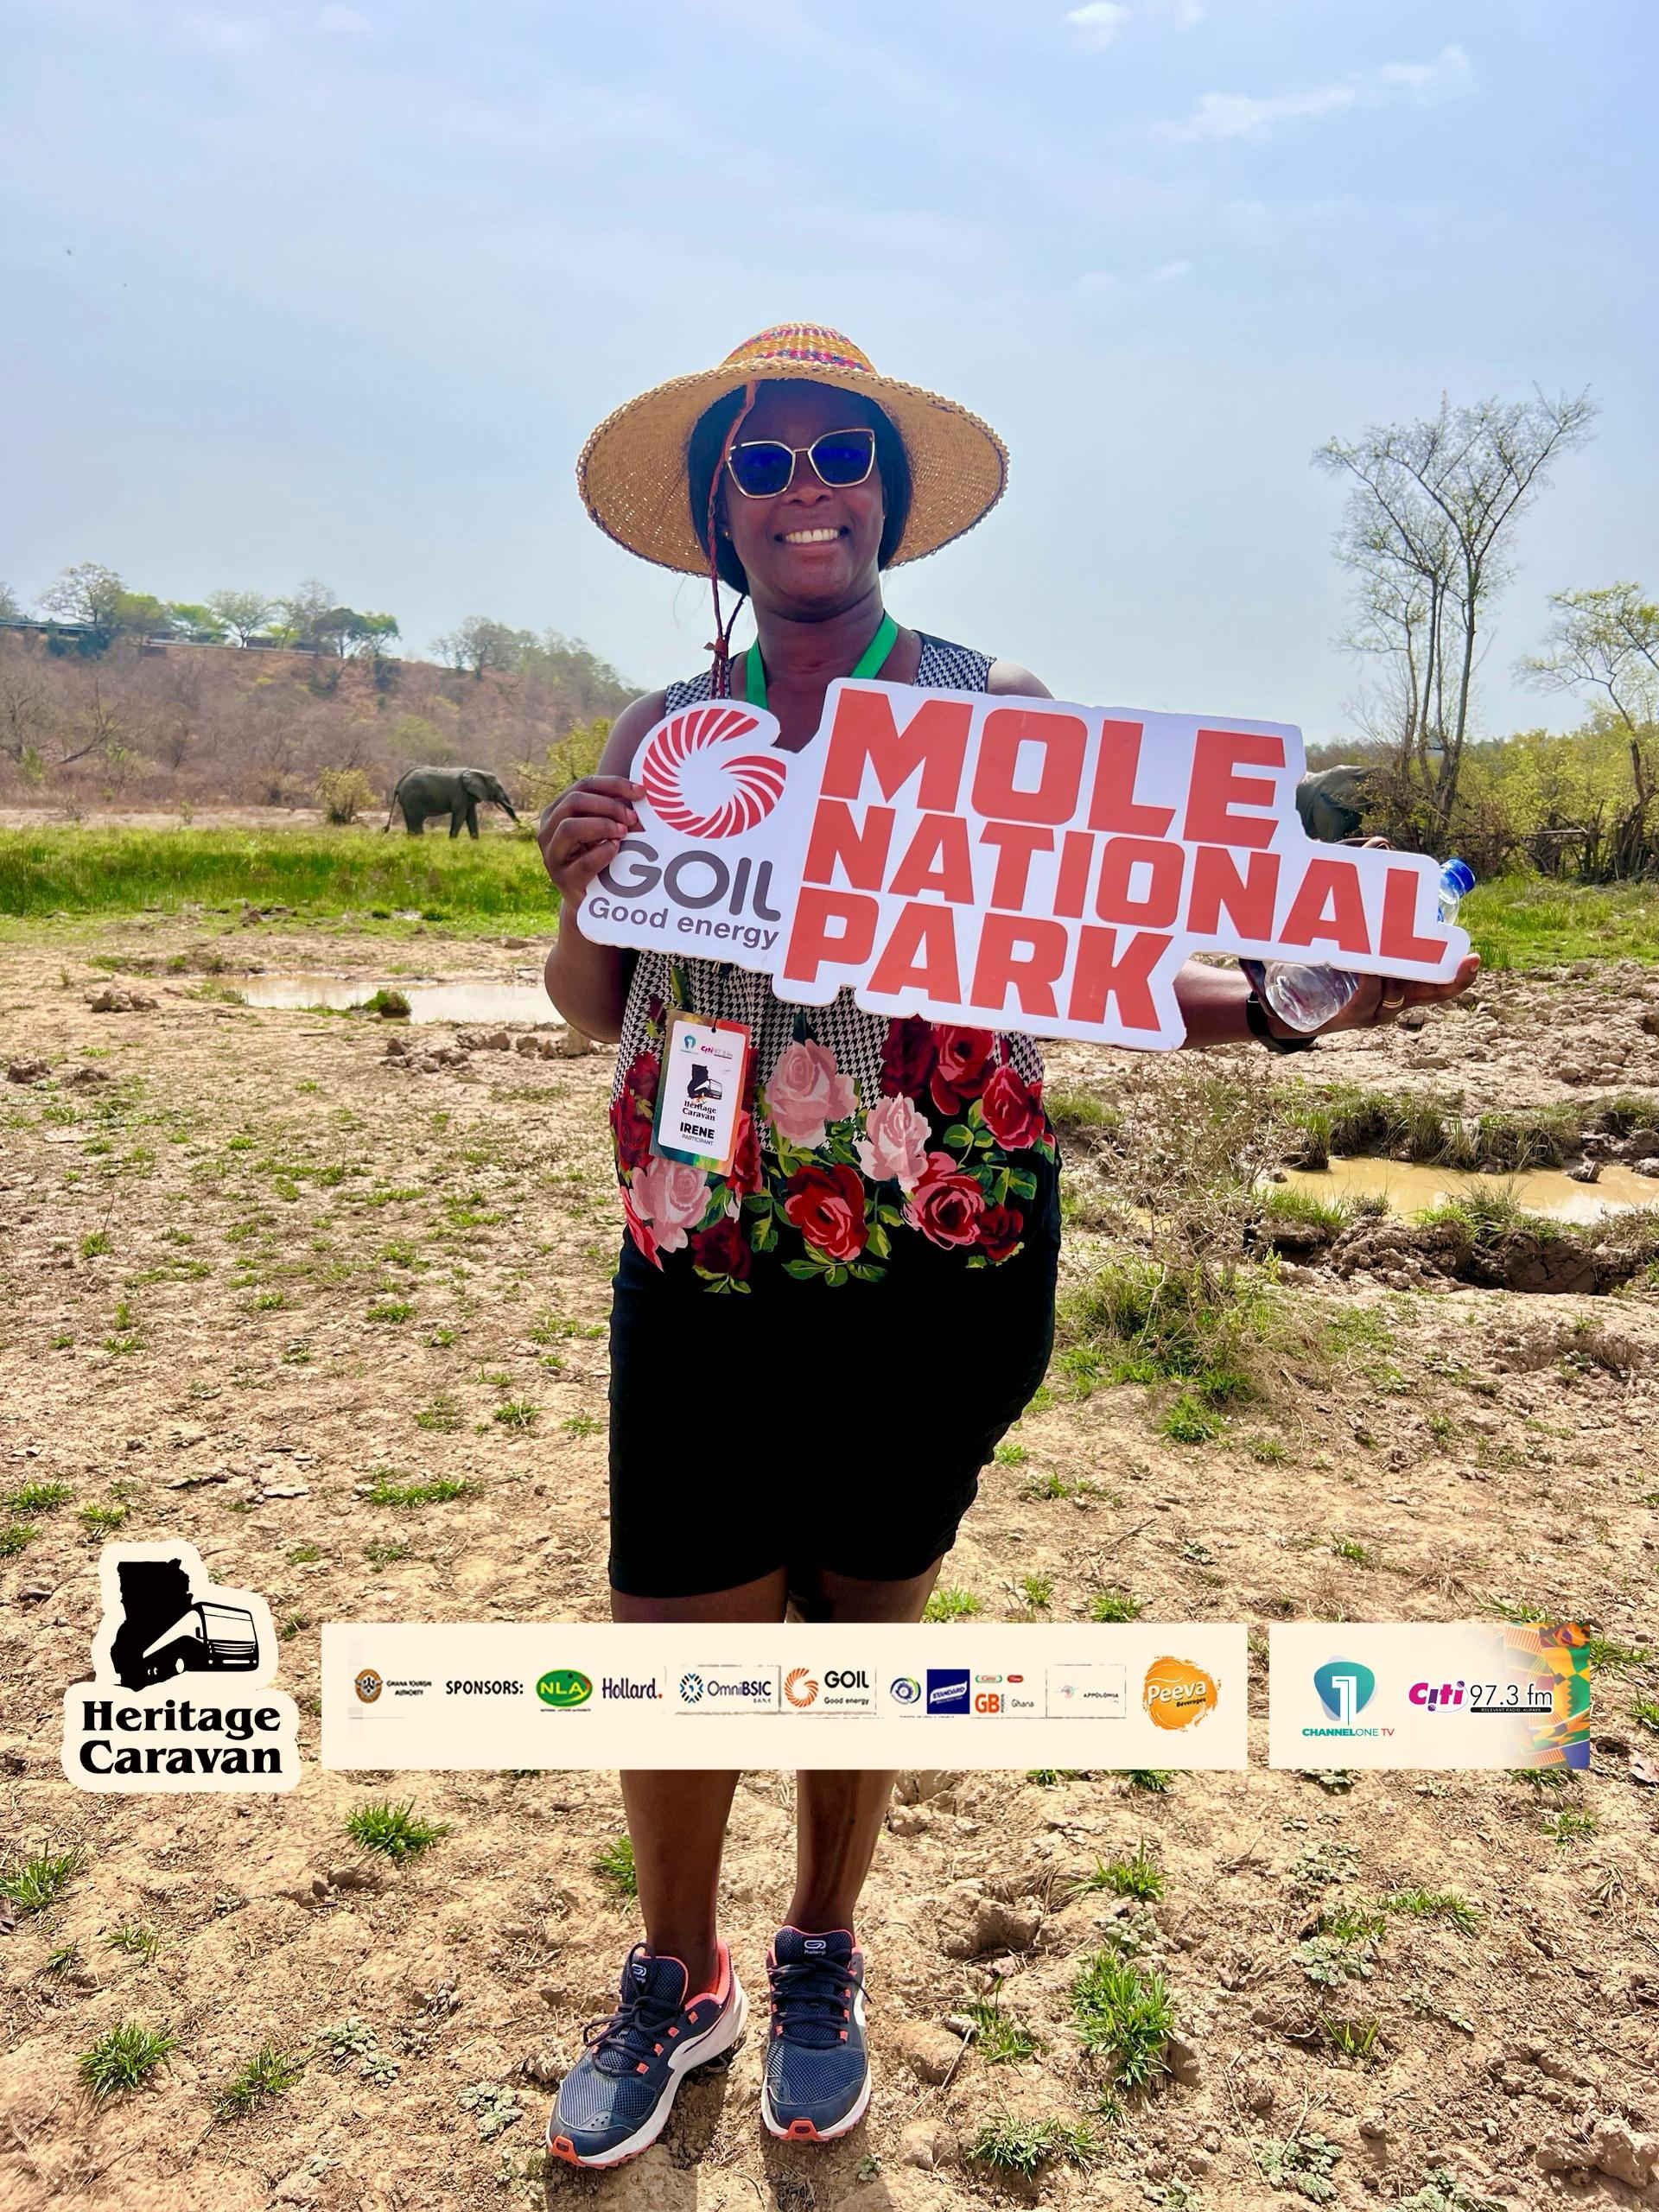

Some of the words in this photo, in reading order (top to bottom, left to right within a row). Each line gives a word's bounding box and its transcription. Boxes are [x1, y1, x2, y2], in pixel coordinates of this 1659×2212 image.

[821, 689, 1283, 849] MOLE
[597, 840, 781, 922] GOIL
[804, 798, 1447, 963] NATIONAL
[588, 897, 669, 929] Good
[677, 917, 779, 950] energy
[784, 887, 1171, 1030] PARK
[679, 1122, 715, 1140] IRENE
[682, 1107, 715, 1121] Caravan
[682, 1134, 714, 1146] PARTICIPANT
